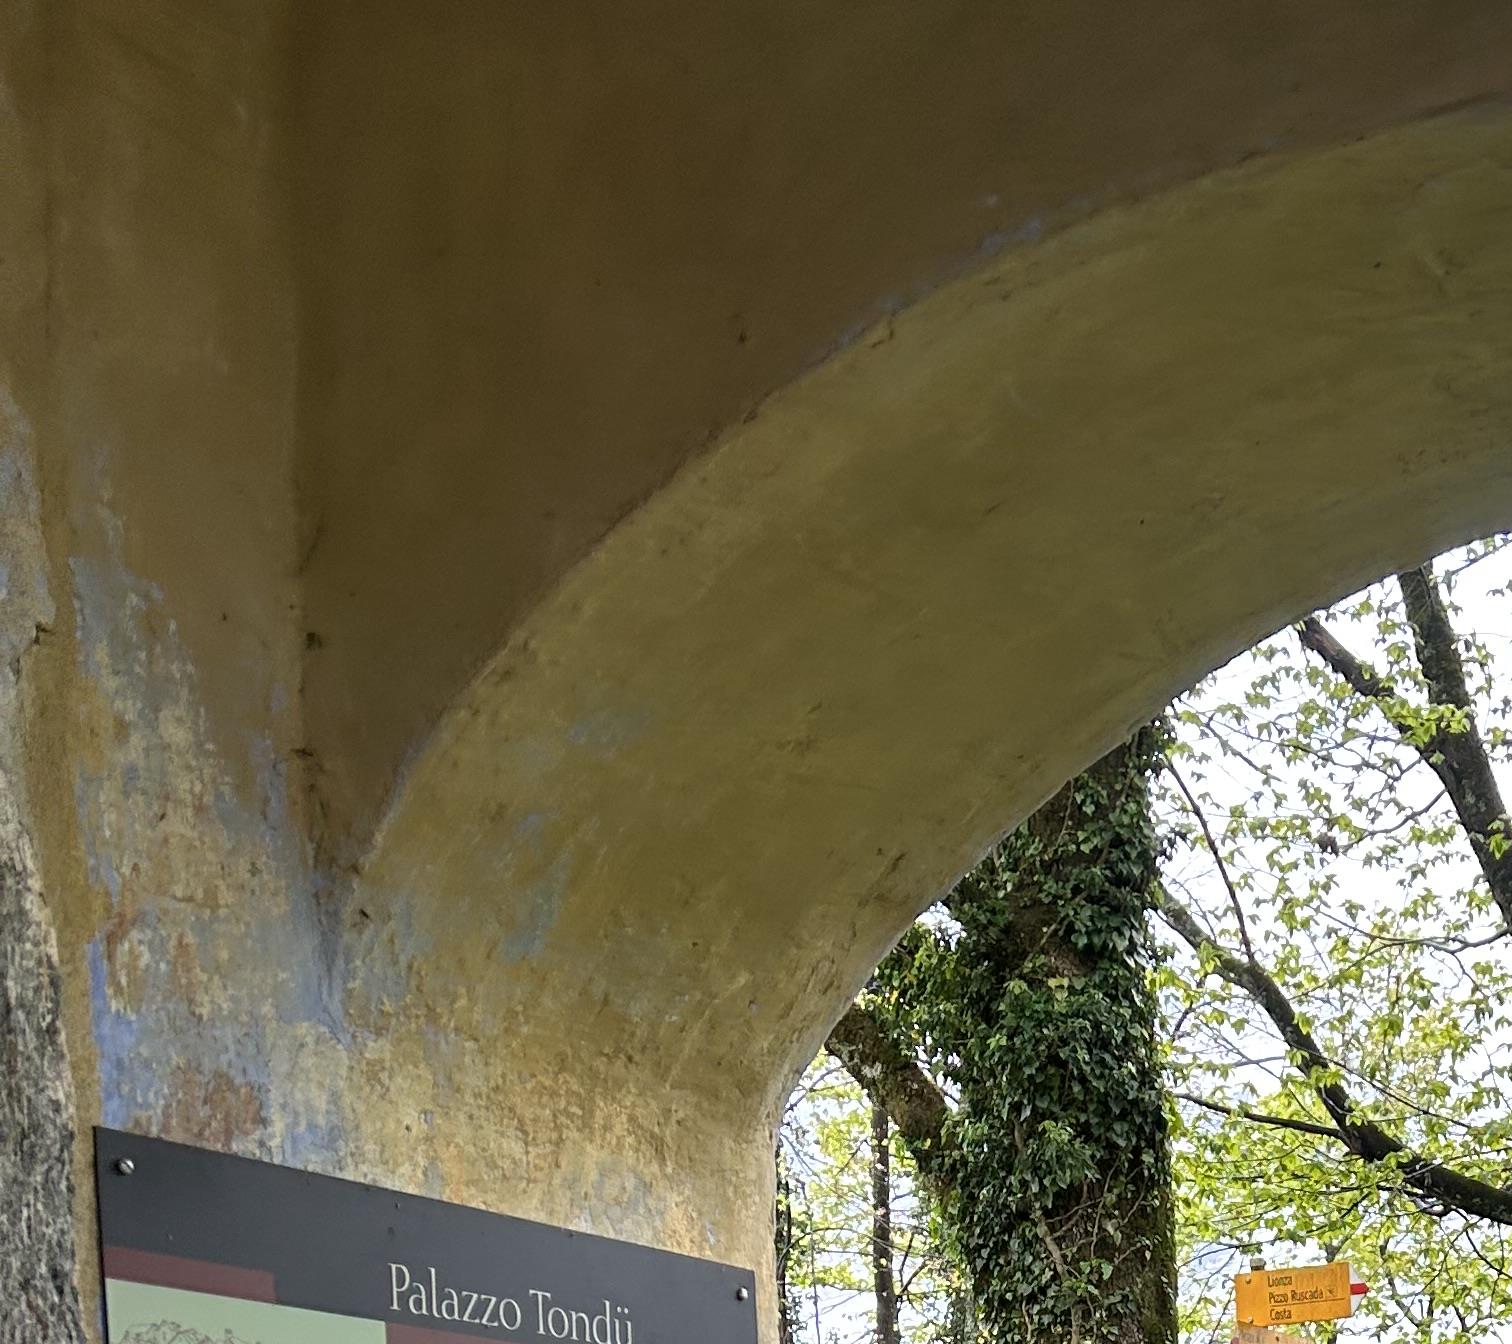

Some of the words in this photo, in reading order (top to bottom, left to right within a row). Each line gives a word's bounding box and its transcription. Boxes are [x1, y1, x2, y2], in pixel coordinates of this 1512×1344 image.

[1267, 1275, 1292, 1288] Lionza
[387, 1262, 522, 1331] Palazzo
[1290, 1287, 1324, 1301] Ruscada
[1269, 1308, 1292, 1321] Costa
